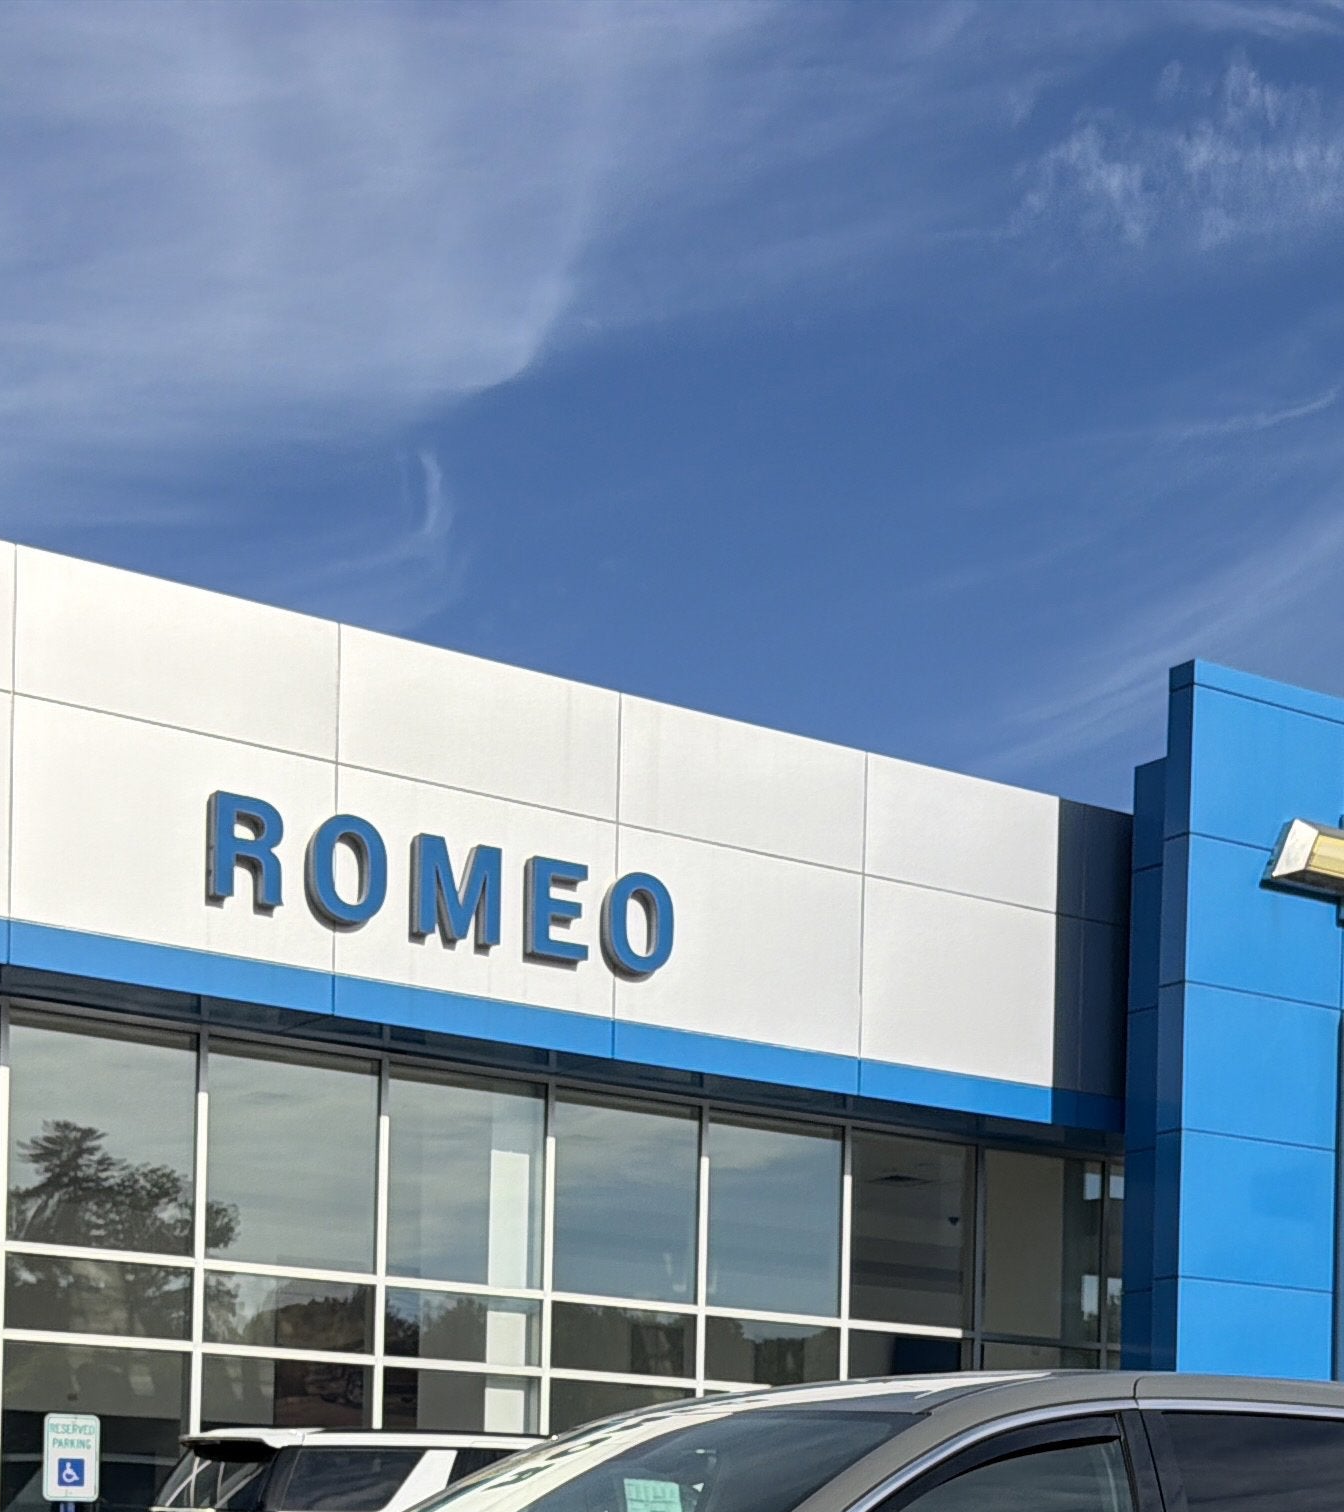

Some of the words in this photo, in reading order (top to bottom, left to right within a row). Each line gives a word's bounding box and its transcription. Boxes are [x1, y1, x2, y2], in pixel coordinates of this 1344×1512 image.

[206, 789, 674, 980] ROMEO
[48, 1423, 96, 1435] RESERVED
[52, 1438, 92, 1449] PARKING
